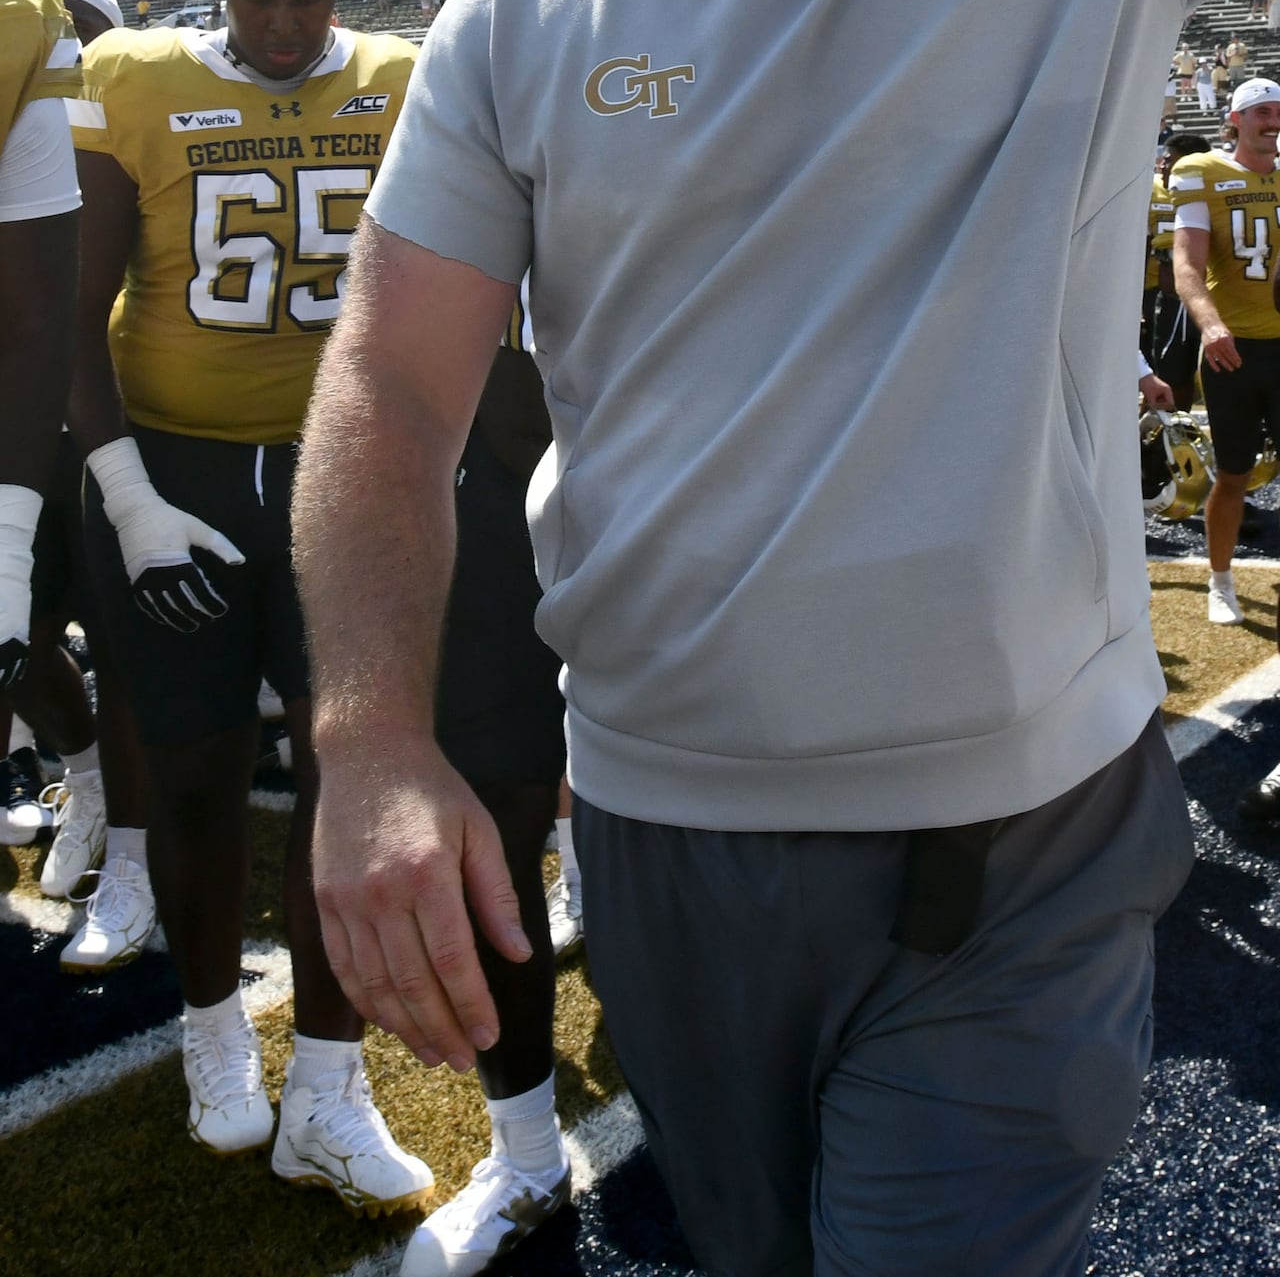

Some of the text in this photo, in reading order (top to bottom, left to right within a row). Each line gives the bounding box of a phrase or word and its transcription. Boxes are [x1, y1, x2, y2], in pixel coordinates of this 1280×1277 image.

[583, 53, 695, 119] GT
[341, 95, 388, 112] ACC
[186, 133, 381, 167] GEORGIA TECH
[1226, 192, 1278, 206] GEORGIA
[186, 164, 376, 334] 65
